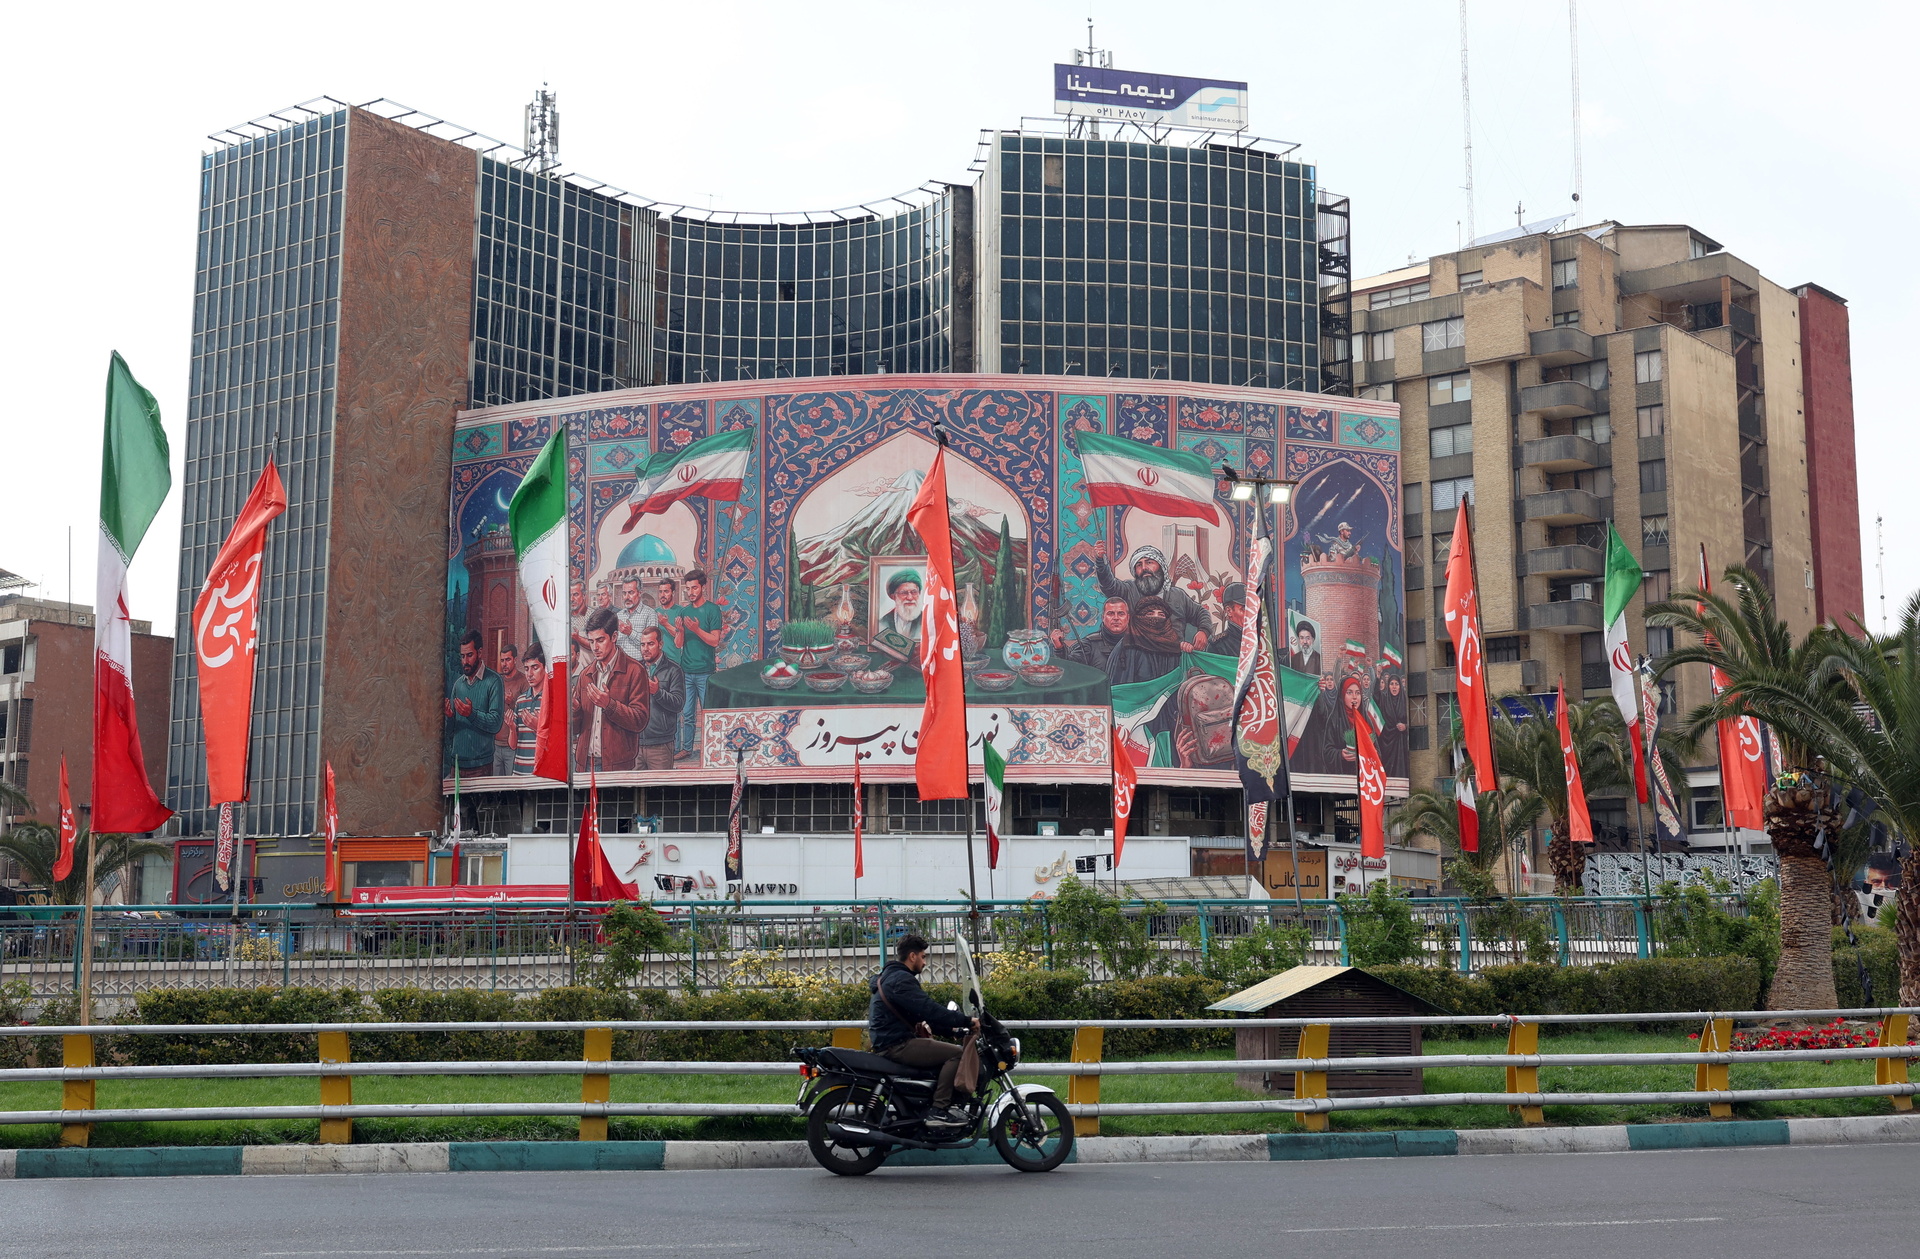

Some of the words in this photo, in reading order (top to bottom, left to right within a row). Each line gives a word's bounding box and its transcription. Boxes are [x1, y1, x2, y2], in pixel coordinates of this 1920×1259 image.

[1067, 74, 1118, 97] سینا
[1120, 83, 1175, 105] بیمه
[1097, 107, 1113, 117] ۰۲۱
[1119, 110, 1146, 120] ۲۸۰۷
[1191, 114, 1245, 125] sinainsurance.com
[805, 717, 901, 761] پیروز
